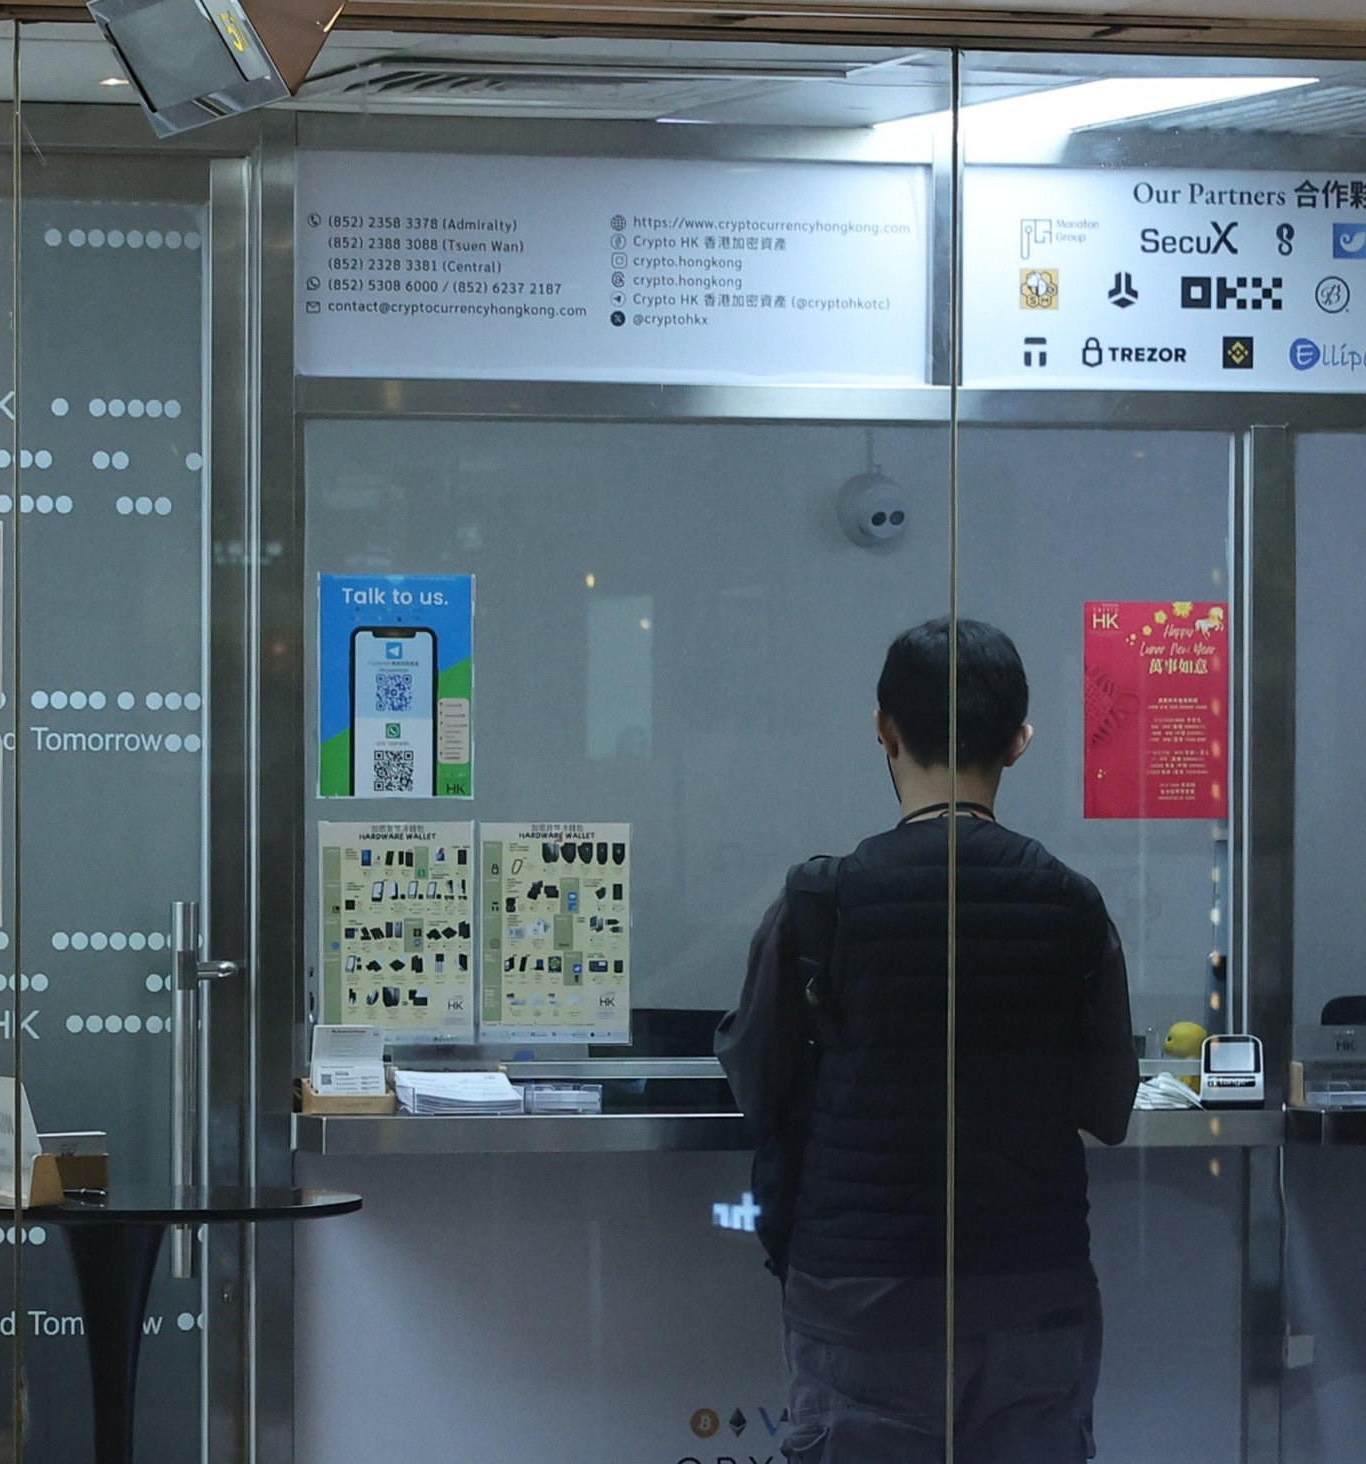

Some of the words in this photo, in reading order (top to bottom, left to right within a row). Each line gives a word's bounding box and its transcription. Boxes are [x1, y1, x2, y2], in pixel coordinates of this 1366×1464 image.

[1132, 181, 1182, 205] Our
[1187, 182, 1286, 207] Partners
[328, 215, 364, 229] (852)
[368, 216, 401, 229] 2358
[405, 217, 439, 230] 3378
[442, 217, 518, 233] (Admiralty)
[633, 216, 911, 235] https://www.cryptocurrencyhongkong.com
[328, 237, 364, 251] (852)
[368, 237, 401, 250] 2388
[405, 238, 439, 251] 3088
[442, 238, 487, 253] (Tsuen
[491, 239, 525, 253] Wan)
[633, 235, 677, 249] Crypto
[681, 236, 699, 249] HK
[1055, 231, 1086, 244] Group
[1140, 220, 1239, 255] SecuX
[328, 258, 364, 272] (852)
[368, 258, 401, 271] 2328
[405, 259, 438, 272] 3381
[442, 260, 502, 274] (Central)
[633, 255, 743, 271] crypto.hongkong
[328, 278, 364, 292] (852)
[368, 279, 401, 292] 5308
[405, 280, 439, 293] 6000
[452, 281, 488, 295] (852)
[492, 282, 525, 295] 6237
[529, 283, 562, 296] 2187
[633, 274, 743, 290] crypto.hongkong
[633, 293, 677, 307] Crypto
[681, 294, 699, 306] HK
[1181, 276, 1283, 311] OKX
[328, 301, 588, 319] contact@cryptocurrencyhongkong.com
[633, 313, 709, 328] @cryptohkx
[1108, 347, 1188, 363] TREZOR
[341, 587, 386, 605] Talk
[392, 588, 413, 605] to
[419, 590, 450, 606] us.
[1092, 613, 1120, 630] HK
[30, 726, 164, 753] Tomorrow
[358, 833, 404, 842] HARDWARE
[405, 832, 437, 841] WALLET
[518, 832, 564, 841] HARDWARE
[565, 832, 596, 841] WALLET
[447, 1000, 464, 1011] HK
[599, 997, 616, 1008] HK
